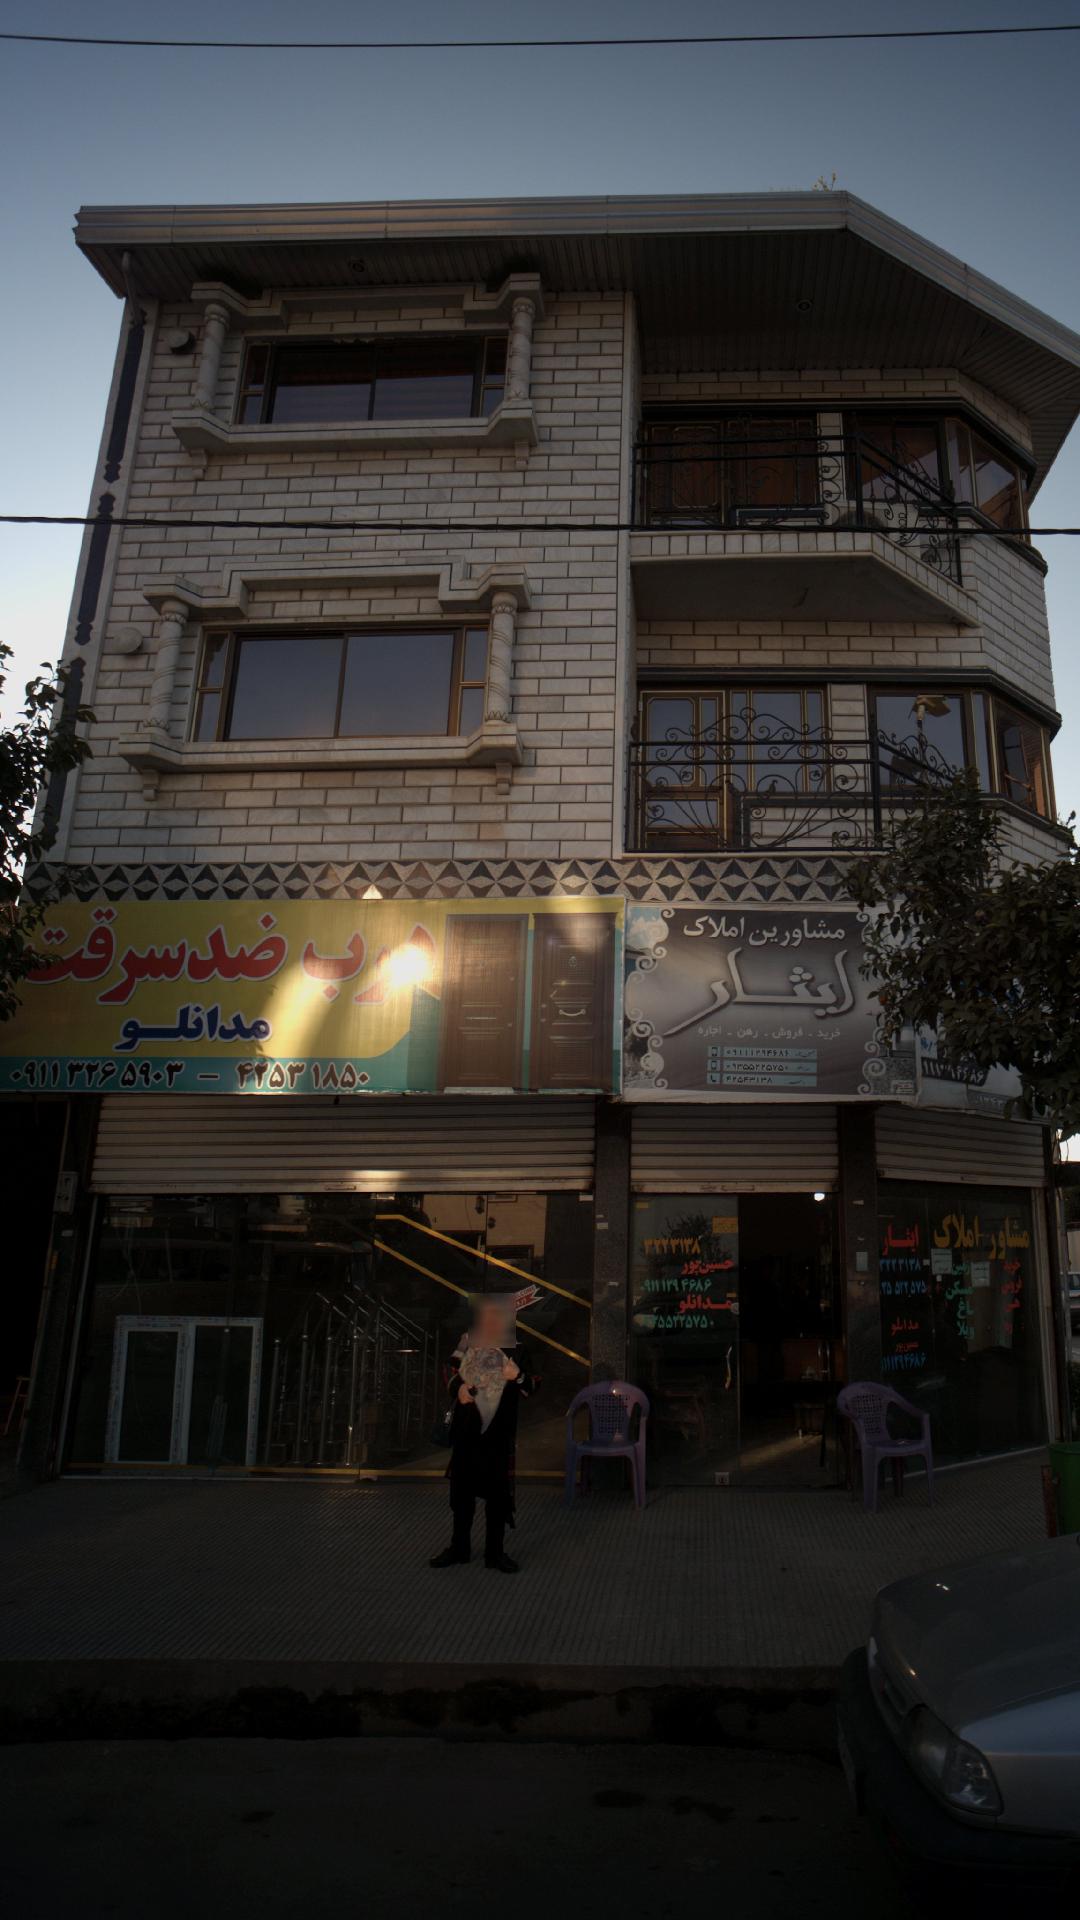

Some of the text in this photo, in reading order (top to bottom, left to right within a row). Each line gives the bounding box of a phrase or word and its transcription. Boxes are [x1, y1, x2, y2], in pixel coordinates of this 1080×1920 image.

[683, 915, 846, 949] مشاورین املاک
[663, 947, 856, 1037] ایثار
[113, 1003, 272, 1051] مدانلو
[697, 1024, 722, 1037] اجاره
[736, 1027, 759, 1039] رهن
[772, 1026, 804, 1040] فروش
[816, 1027, 841, 1040] خرید
[10, 1060, 59, 1088] ۰۹۱۱
[66, 1061, 114, 1088] ۳۲۶
[120, 1061, 184, 1088] ۵۹۰۳
[236, 1061, 305, 1088] ۴۲۵۳
[312, 1062, 370, 1090] ۱۸۵۰
[678, 1293, 732, 1314] مدانلو
